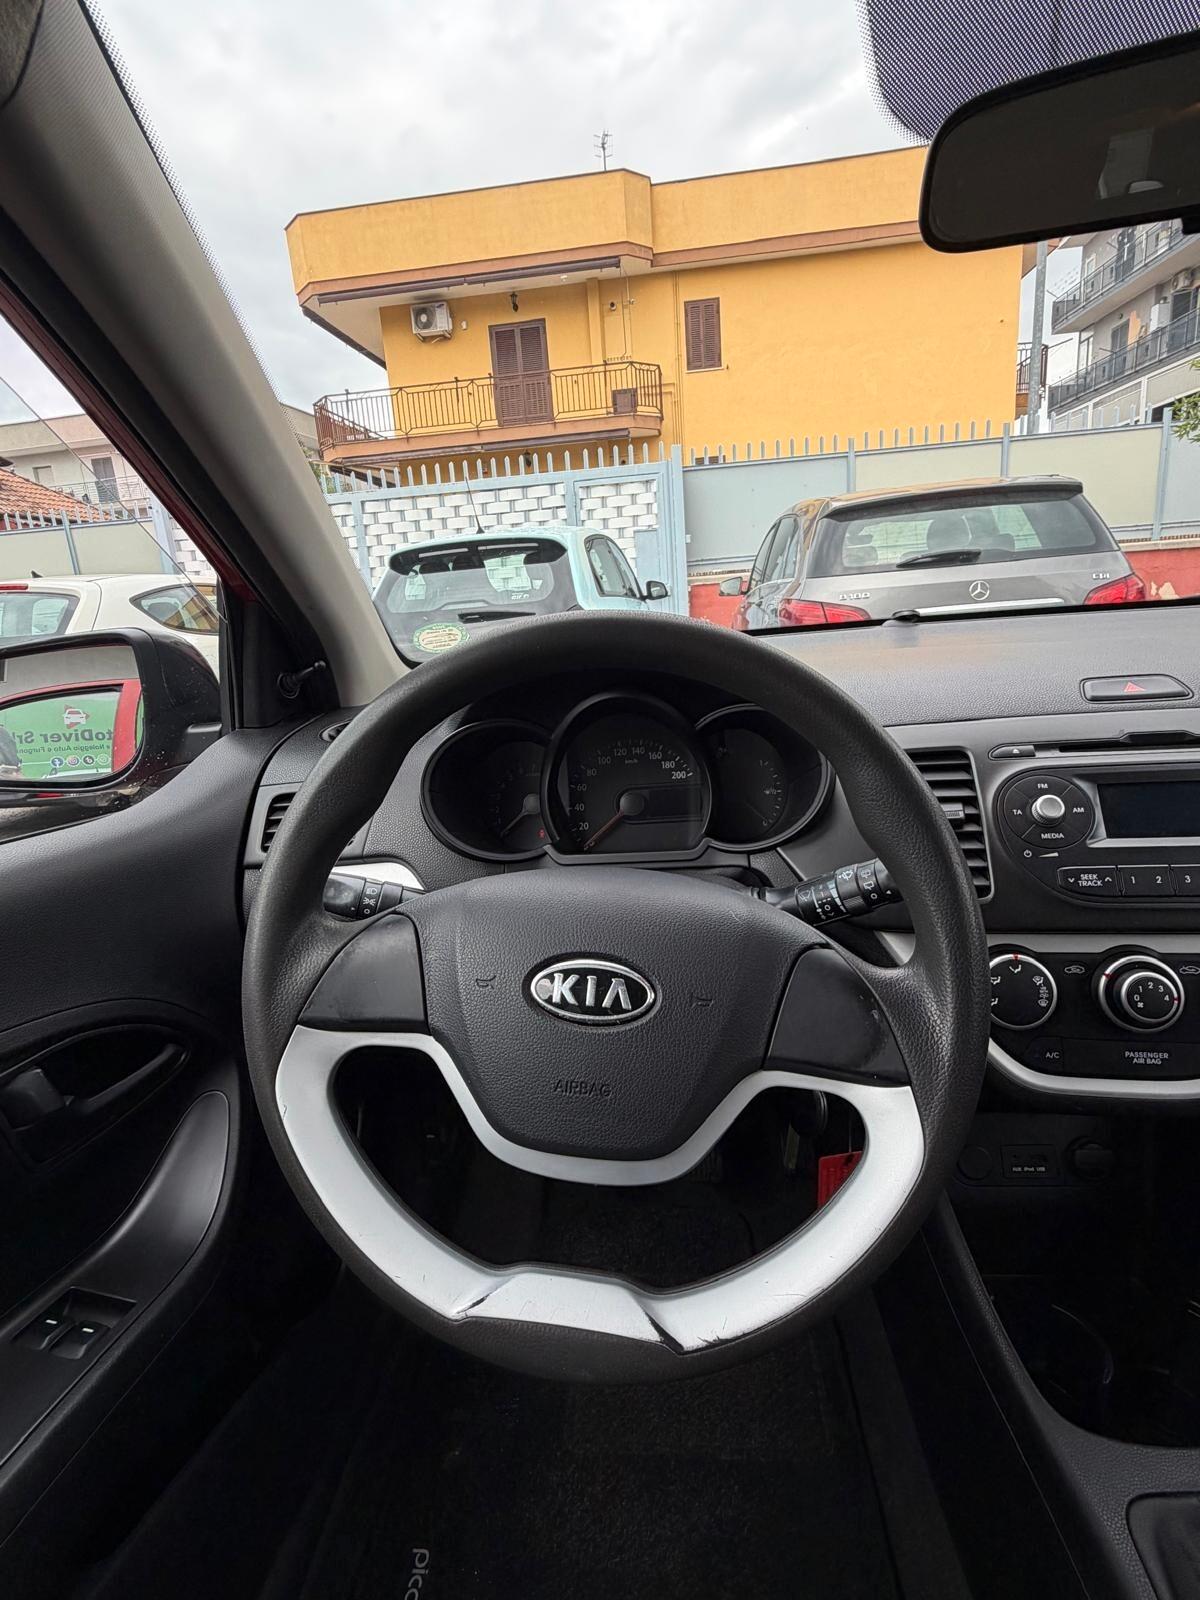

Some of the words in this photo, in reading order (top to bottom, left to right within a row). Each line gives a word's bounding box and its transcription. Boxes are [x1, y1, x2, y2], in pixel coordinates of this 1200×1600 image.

[614, 748, 627, 757] 120
[632, 746, 645, 755] 140
[648, 751, 662, 760] 160
[597, 756, 611, 765] 100
[661, 760, 675, 769] 180
[586, 767, 597, 777] 80
[671, 770, 687, 779] 200
[576, 783, 587, 792] 60
[574, 803, 585, 811] 40
[578, 822, 590, 831] 20
[1078, 879, 1103, 887] TRACK
[1155, 875, 1162, 884] 2
[1184, 875, 1191, 883] 3
[1147, 981, 1154, 989] 2
[1158, 985, 1164, 993] 3
[552, 973, 632, 1011] KIA
[1045, 1051, 1060, 1059] A/C
[1124, 1051, 1169, 1059] PASSENGER
[553, 1079, 612, 1097] AIRBAG
